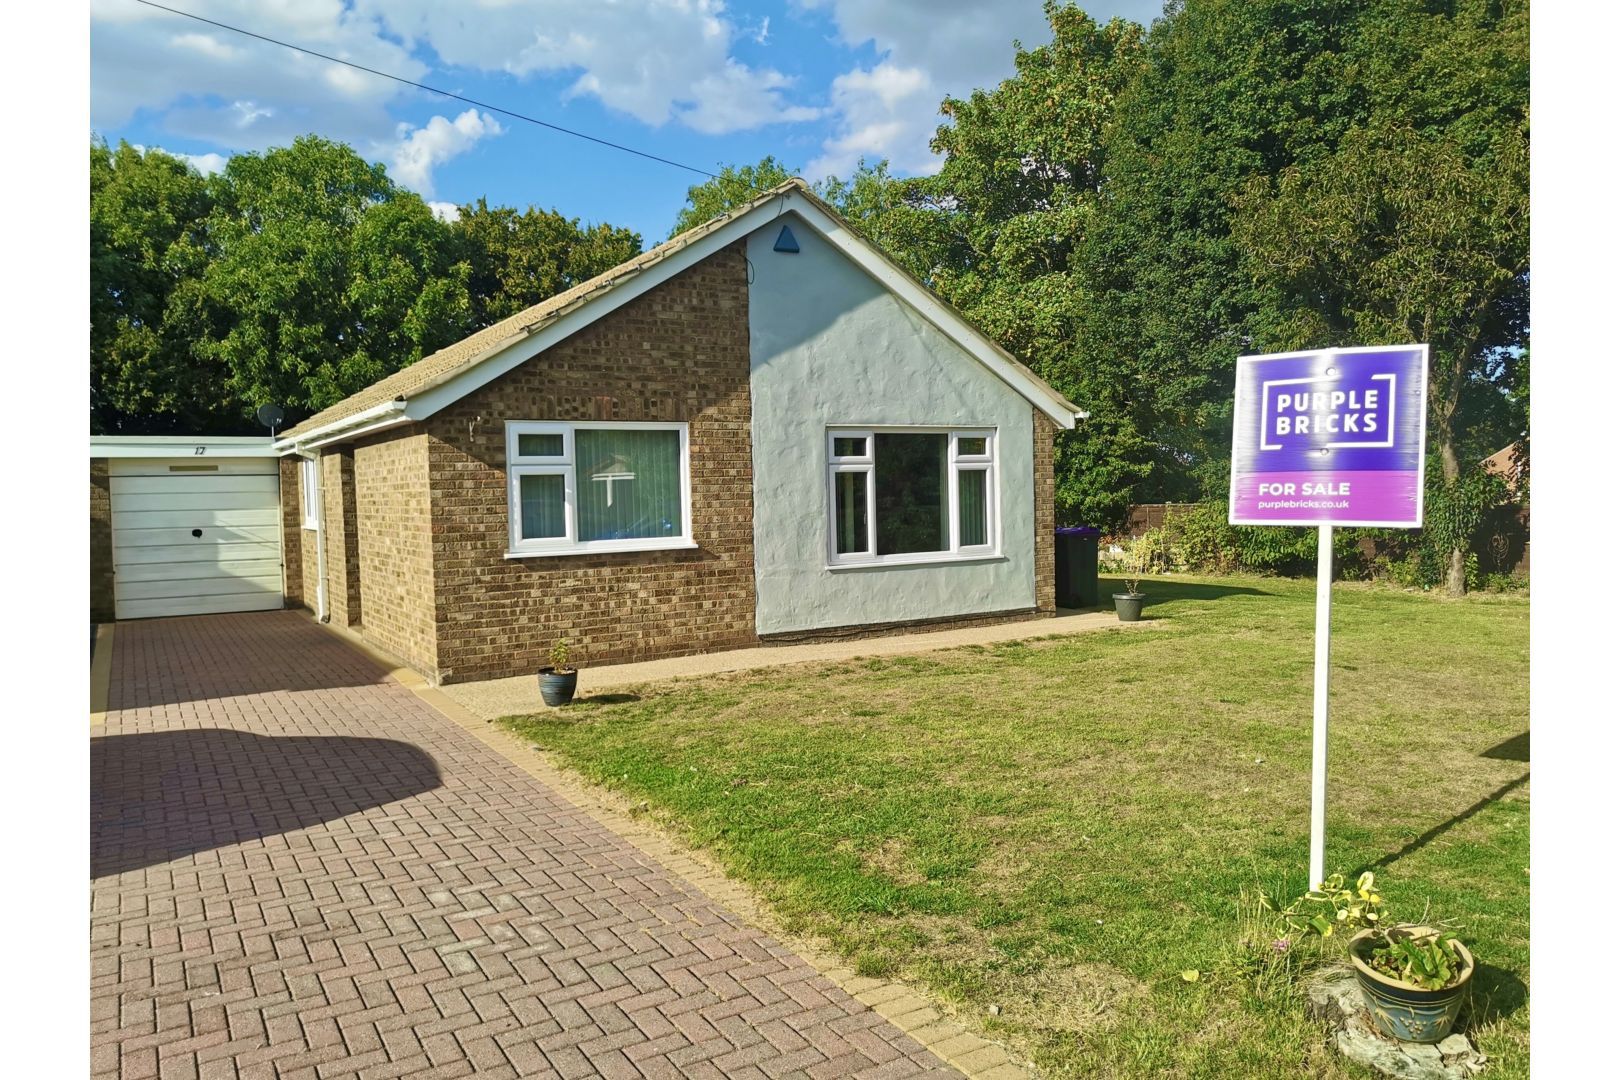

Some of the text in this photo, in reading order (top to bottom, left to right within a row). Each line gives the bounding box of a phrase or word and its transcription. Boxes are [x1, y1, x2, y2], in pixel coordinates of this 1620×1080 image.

[1277, 390, 1378, 412] PURPLE
[1276, 413, 1377, 435] BRICKS
[1258, 482, 1351, 496] FOR SALE
[1258, 499, 1349, 509] purplebricks.co.uk
